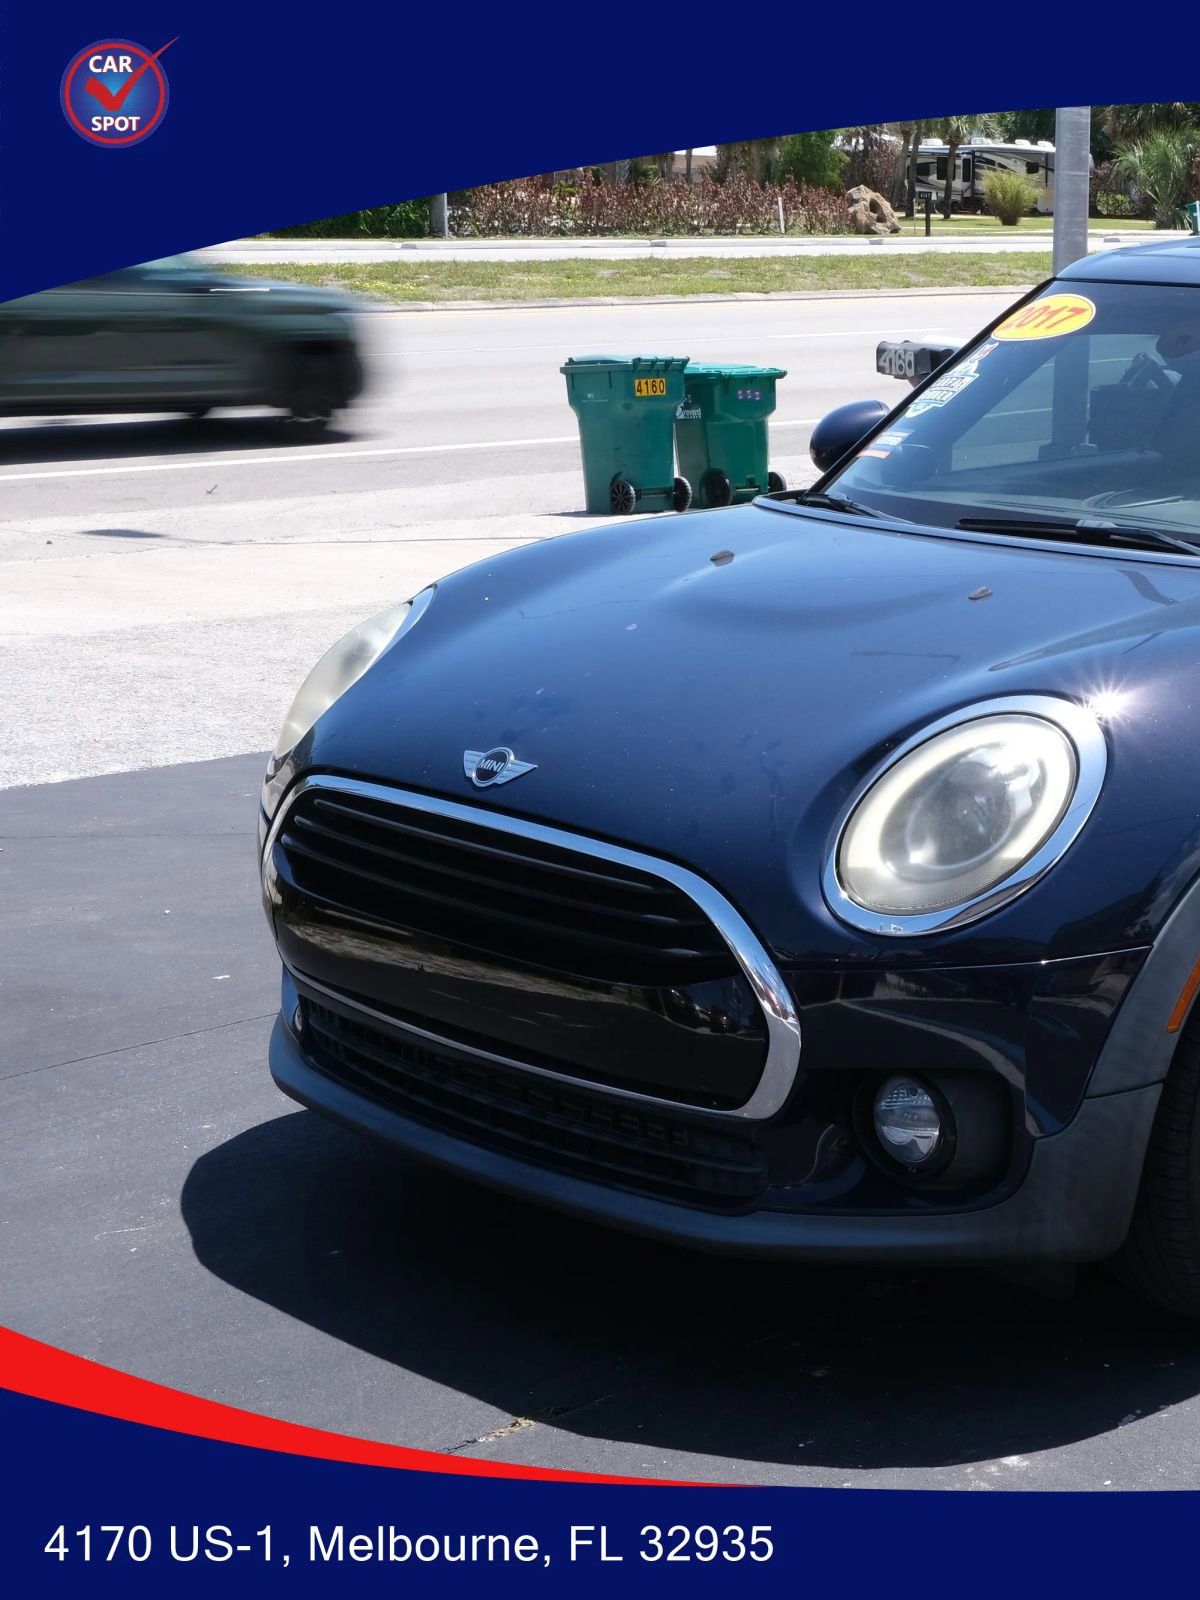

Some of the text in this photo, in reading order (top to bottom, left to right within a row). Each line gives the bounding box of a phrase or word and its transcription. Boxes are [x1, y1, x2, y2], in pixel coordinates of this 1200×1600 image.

[1001, 305, 1089, 330] 2017
[878, 349, 915, 377] 4160
[636, 379, 665, 395] 4160
[478, 759, 505, 773] MINI
